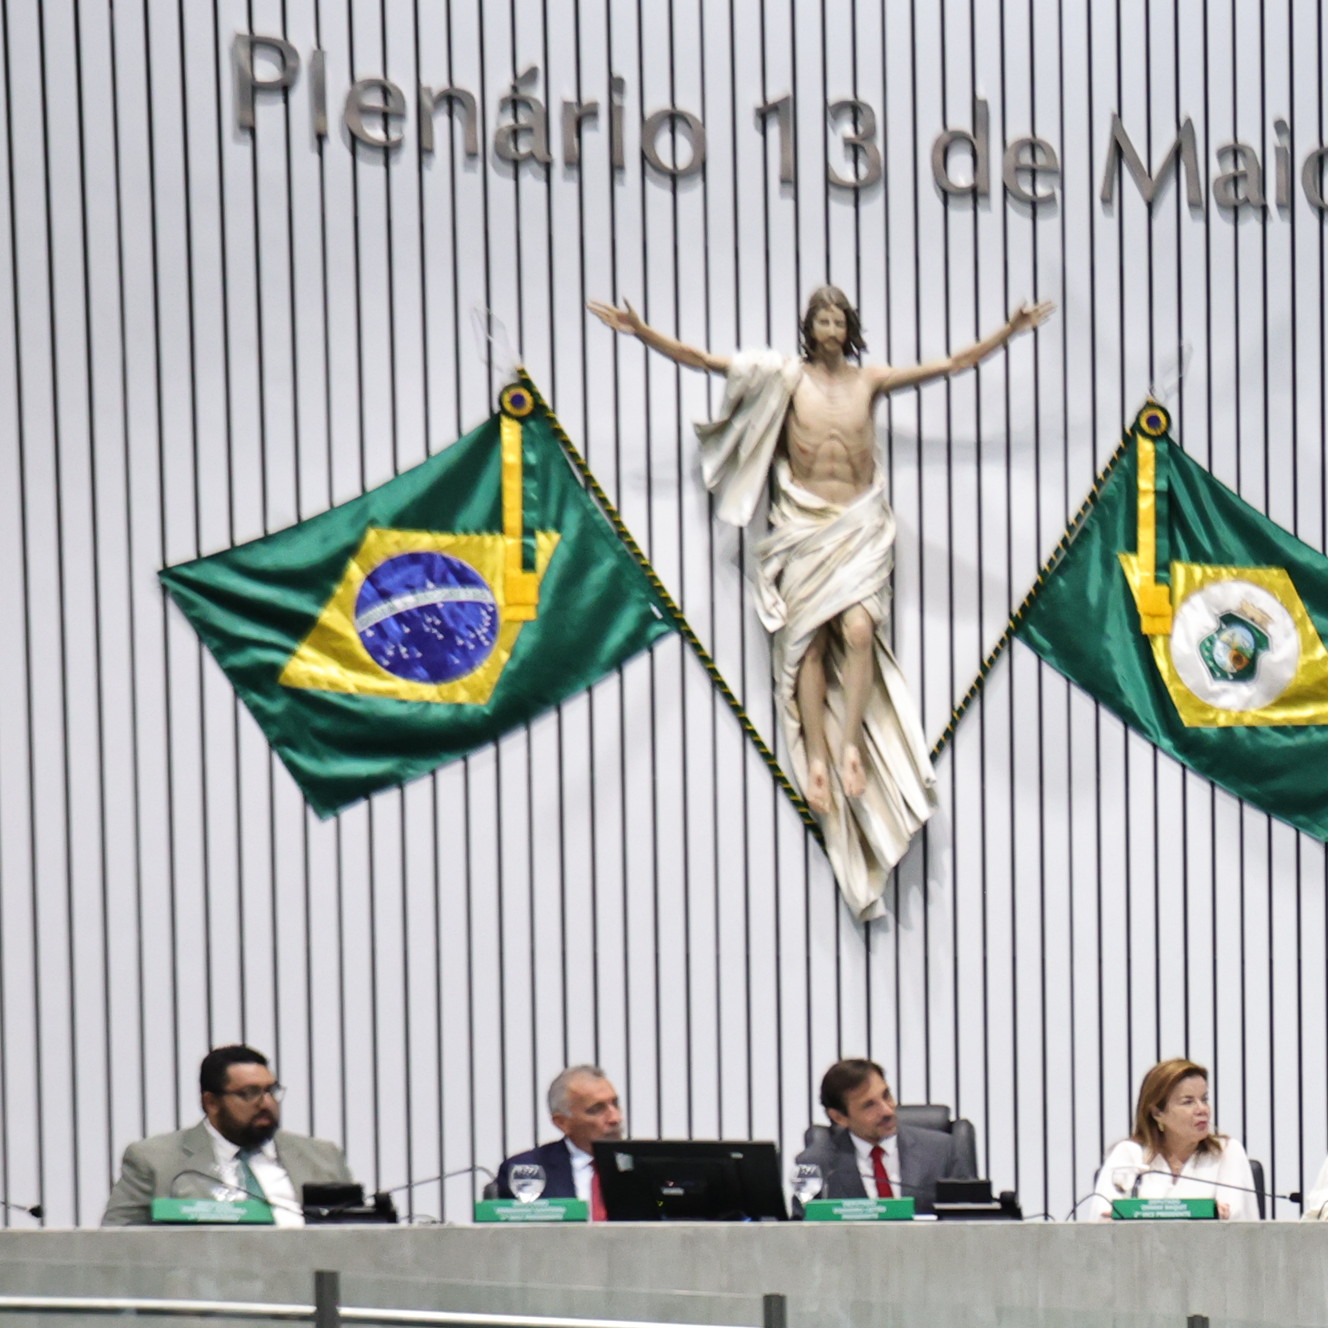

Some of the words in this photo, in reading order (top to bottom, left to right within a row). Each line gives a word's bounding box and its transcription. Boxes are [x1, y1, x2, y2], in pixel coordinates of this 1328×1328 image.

[232, 33, 707, 176] Plenário
[755, 96, 882, 190] 13
[932, 98, 1059, 203] de
